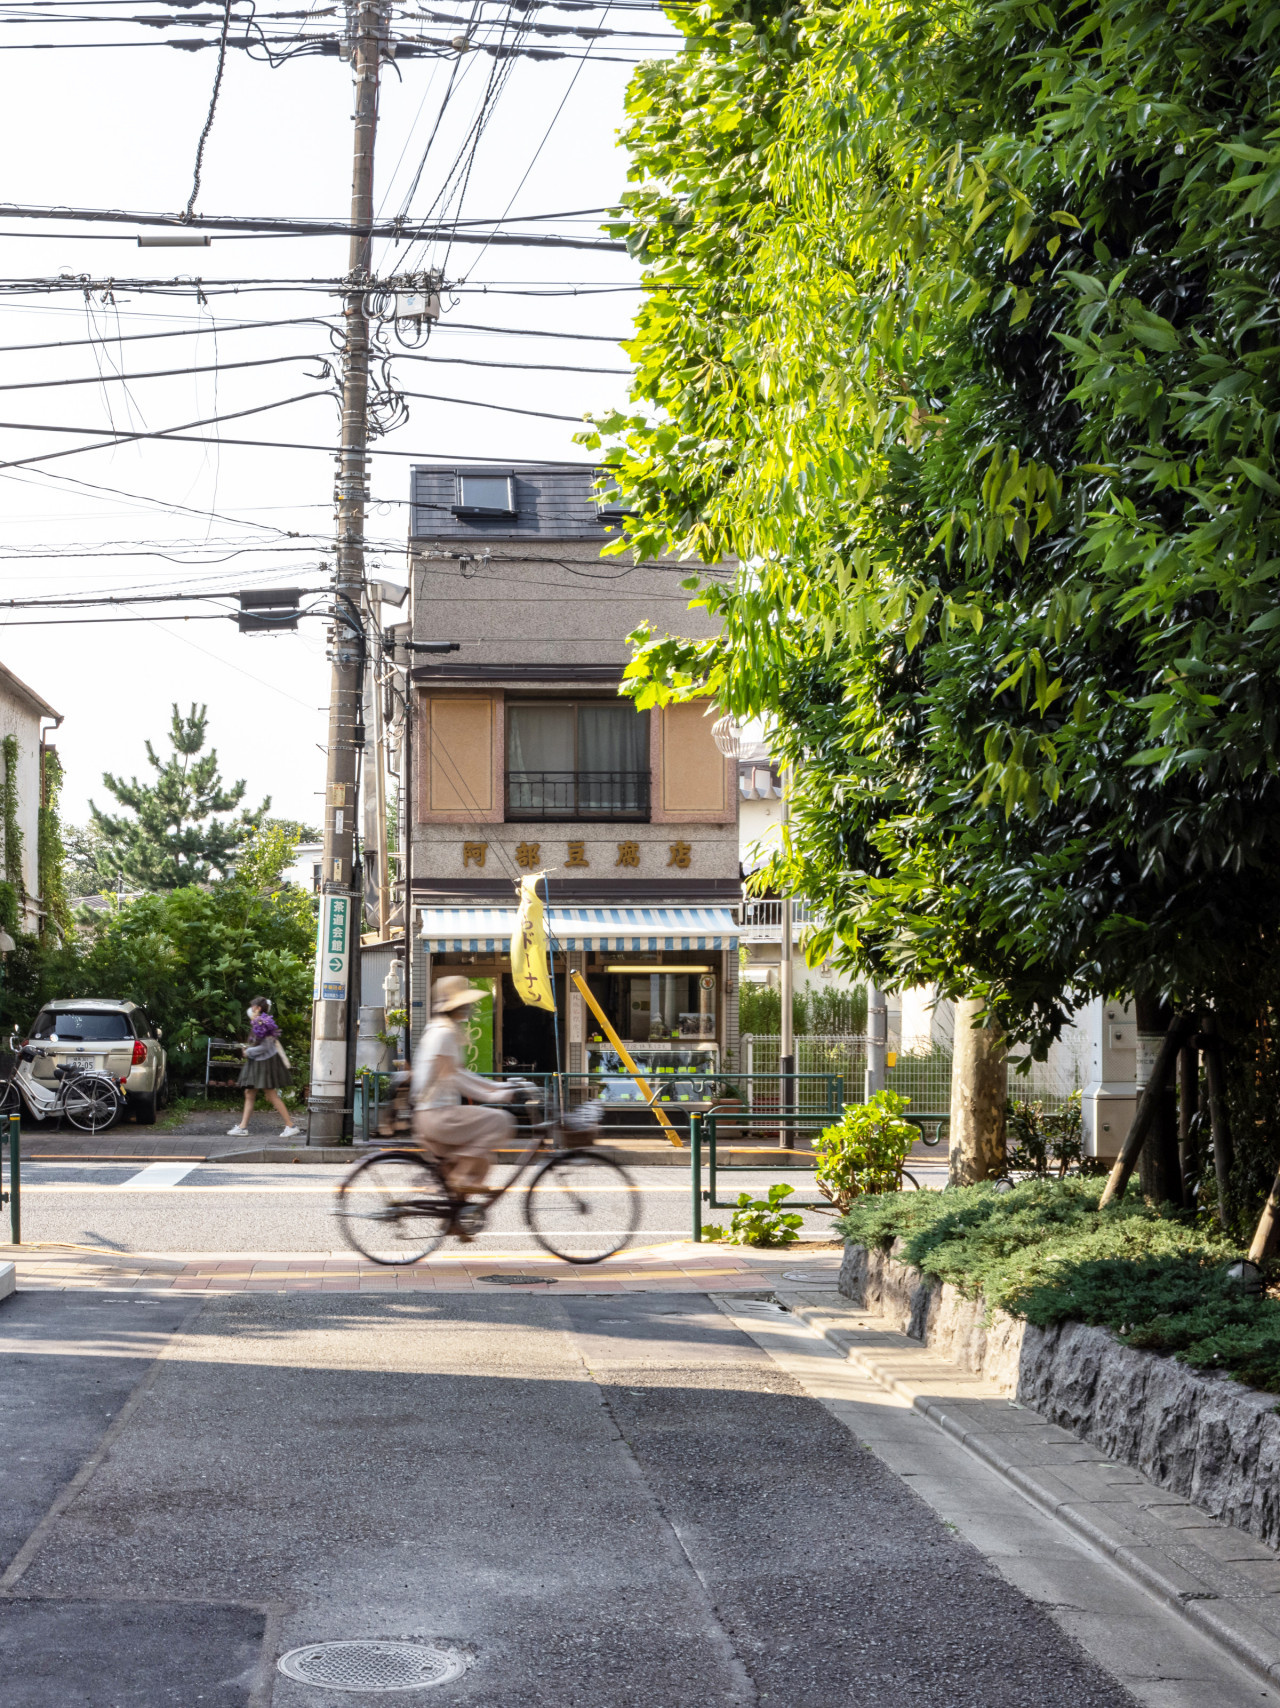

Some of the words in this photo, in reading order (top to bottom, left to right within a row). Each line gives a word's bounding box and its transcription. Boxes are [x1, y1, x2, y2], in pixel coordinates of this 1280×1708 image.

[462, 839, 692, 870] 阿部豆腐店
[331, 901, 345, 952] 茶道会館
